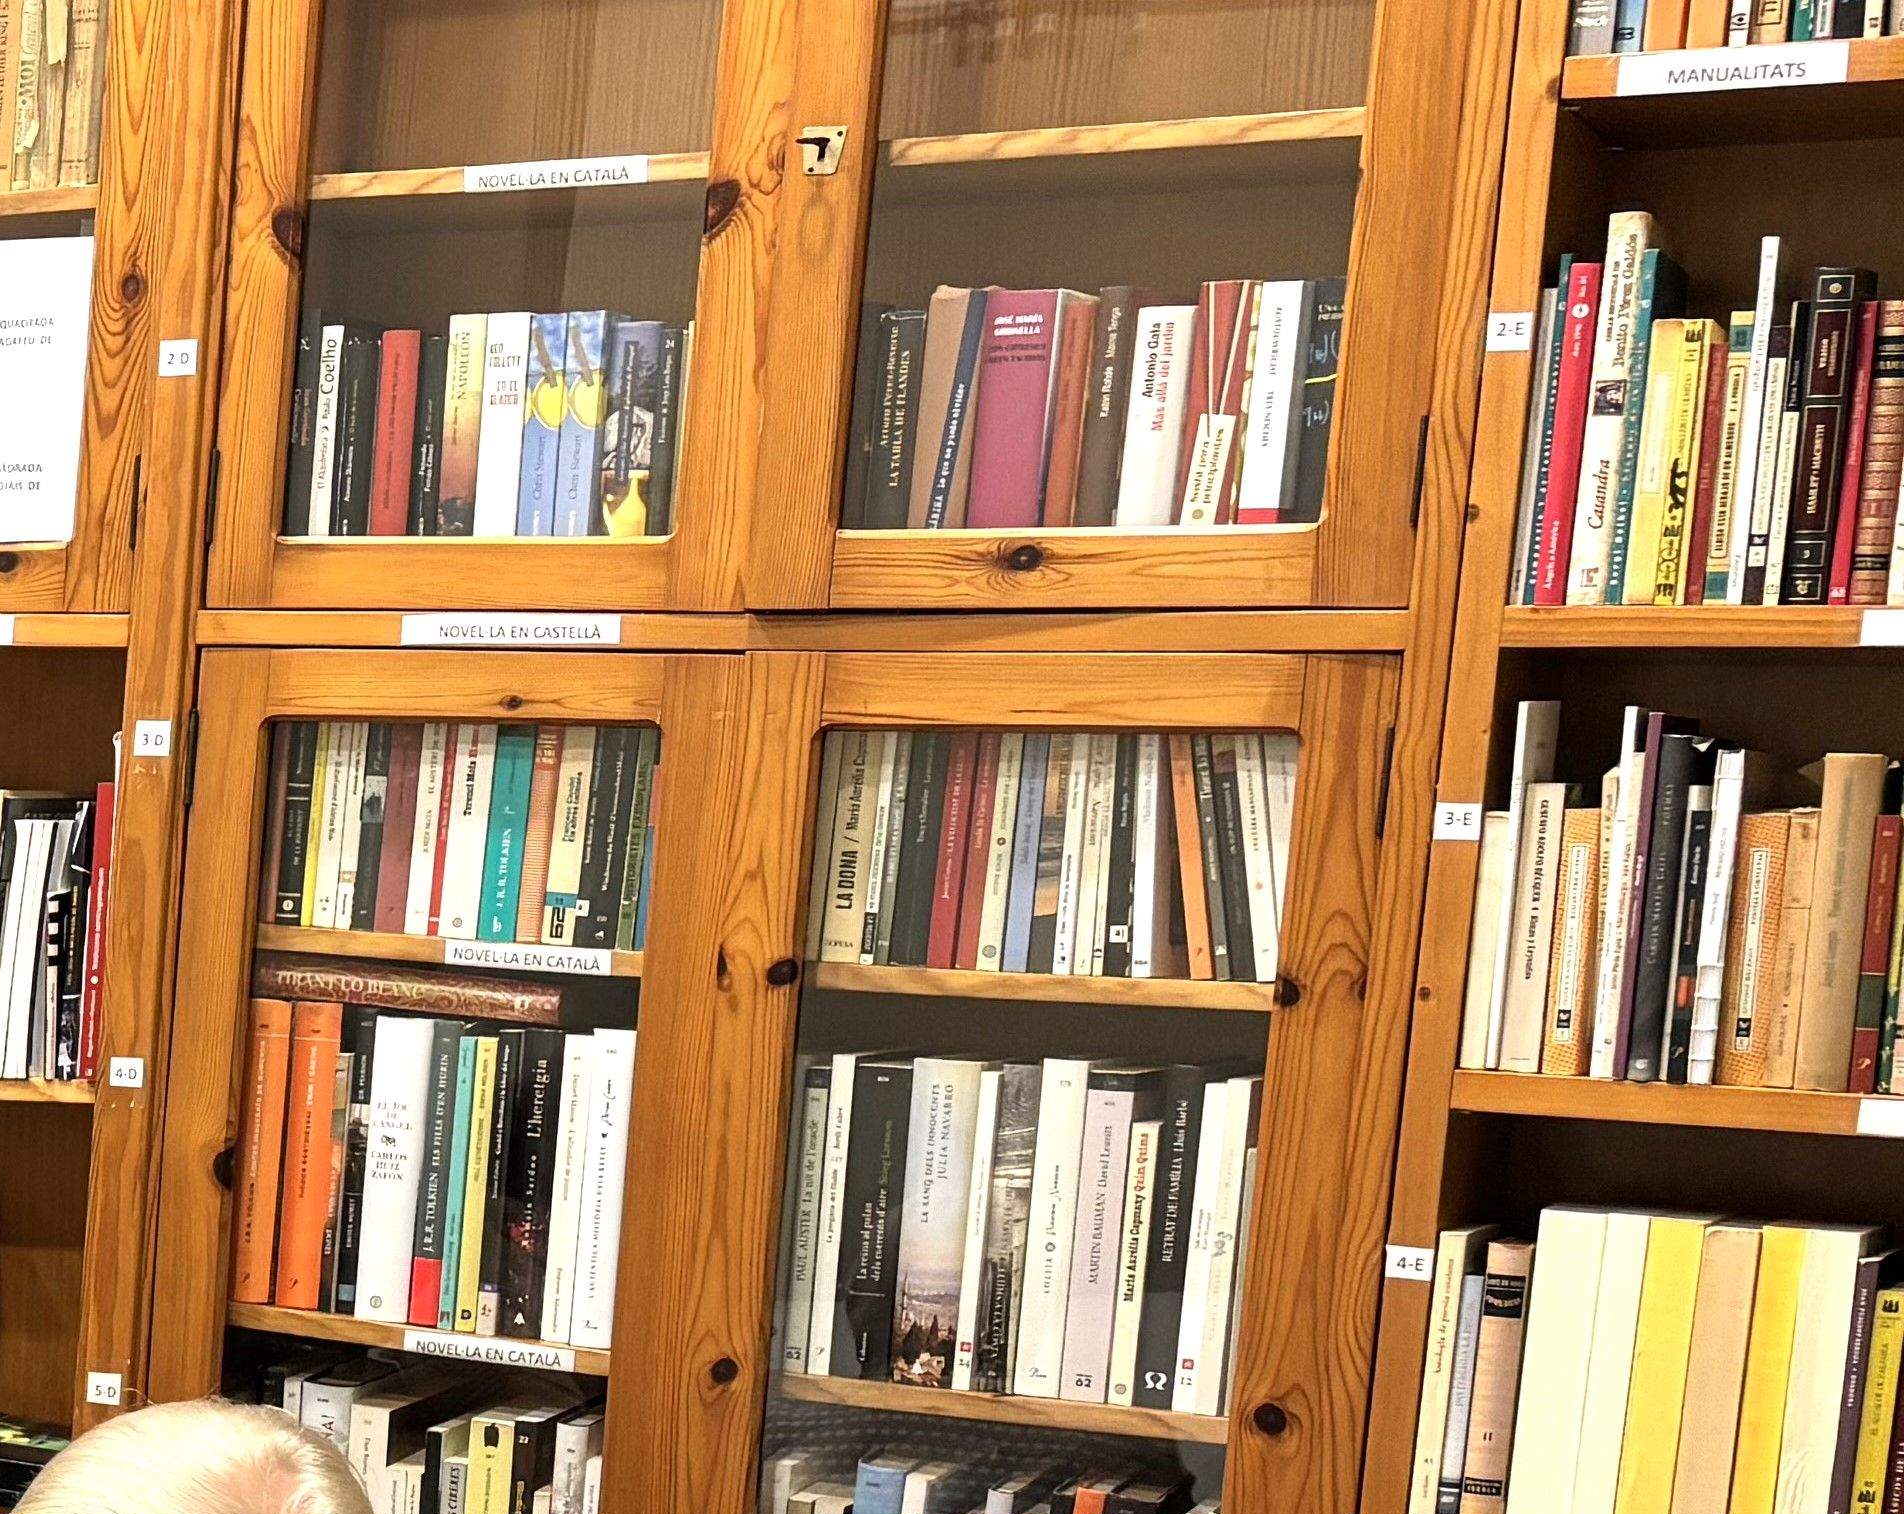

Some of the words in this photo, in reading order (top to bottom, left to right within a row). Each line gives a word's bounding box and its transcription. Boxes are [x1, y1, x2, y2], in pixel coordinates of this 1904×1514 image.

[1667, 61, 1807, 84] MANUALITATS
[551, 172, 568, 183] EN
[573, 165, 629, 182] CATALÀ
[1147, 320, 1162, 348] Gala
[1497, 321, 1525, 337] 2-E
[320, 338, 339, 396] Coelho
[1141, 350, 1159, 398] Antonio
[1588, 457, 1610, 531] Casandra
[511, 625, 528, 639] EN
[533, 623, 601, 639] CASTELLÀ
[1444, 810, 1472, 825] 3-E
[836, 849, 859, 887] DONA
[833, 888, 853, 911] LA
[524, 953, 542, 966] EN
[546, 953, 600, 972] CATALÀ
[940, 1083, 955, 1139] NAVARRO
[937, 1143, 949, 1179] JULIA
[1396, 1256, 1424, 1271] 4-E
[485, 1347, 502, 1361] EN
[508, 1351, 561, 1368] CATALÀ
